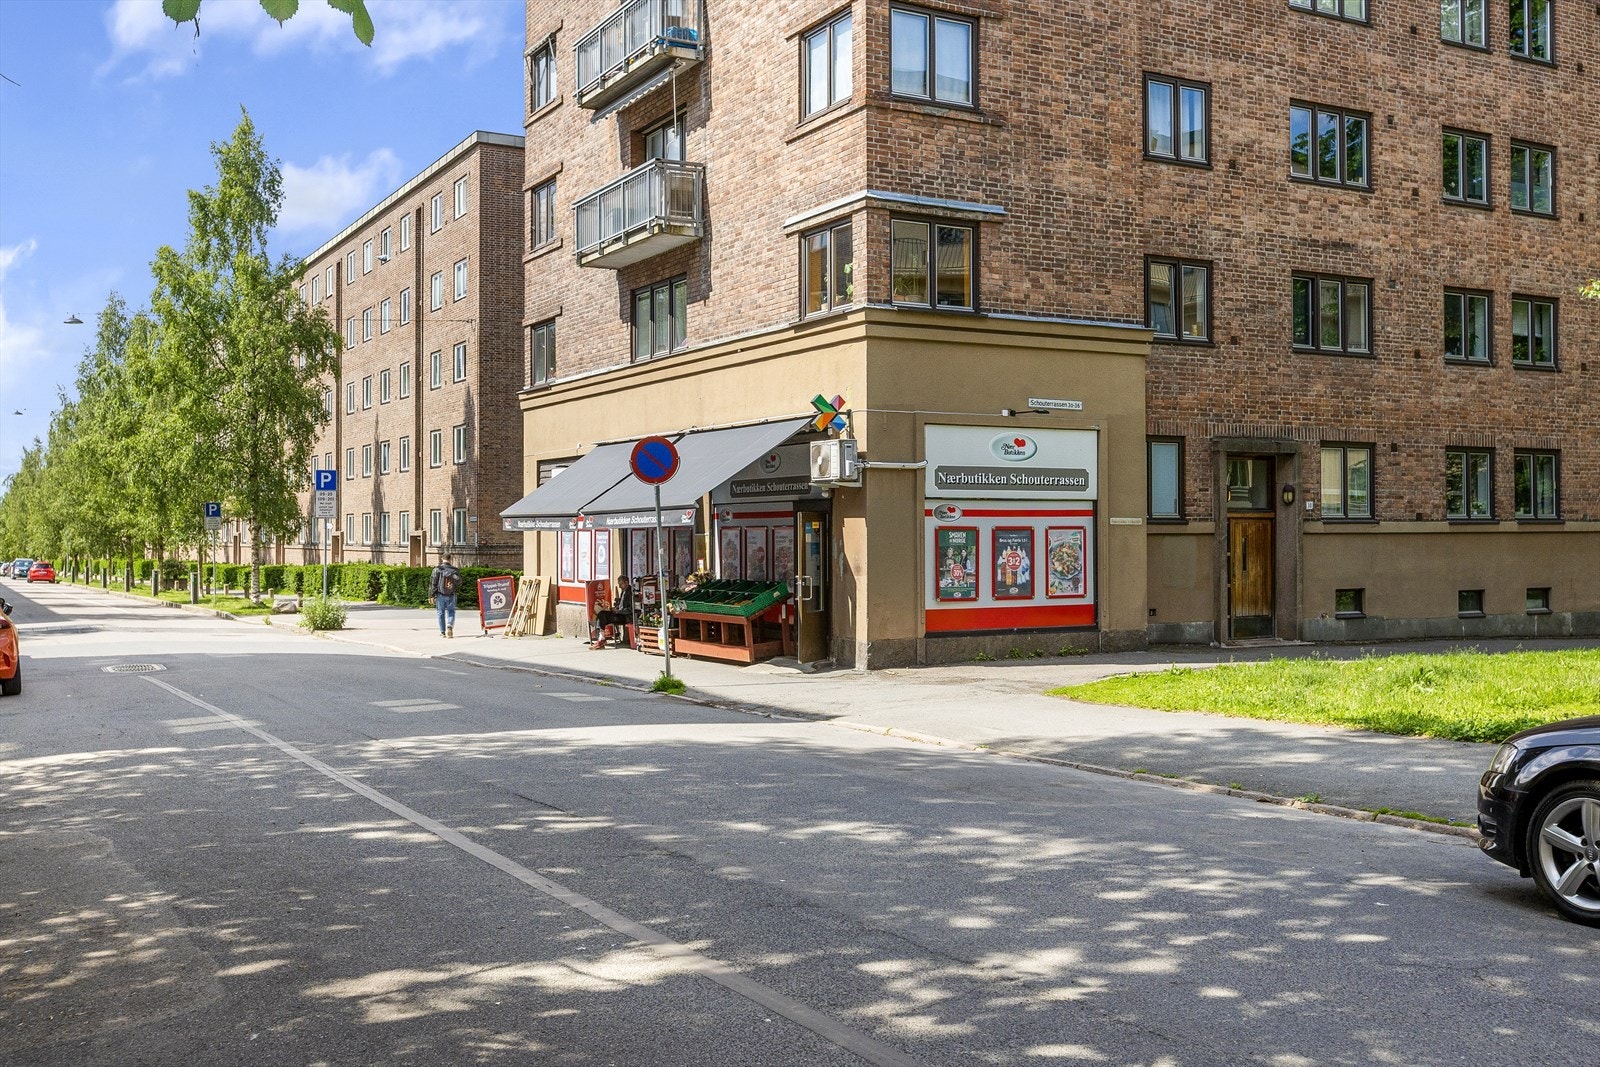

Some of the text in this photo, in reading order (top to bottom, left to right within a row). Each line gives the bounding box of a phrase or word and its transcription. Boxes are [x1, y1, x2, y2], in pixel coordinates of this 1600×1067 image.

[1030, 400, 1067, 408] Schouterrassen
[321, 472, 332, 488] P
[938, 472, 1086, 488] Nærbutikken Schouterrassen
[732, 482, 809, 494] Nærbutikken Schouterrassen
[209, 504, 218, 516] P
